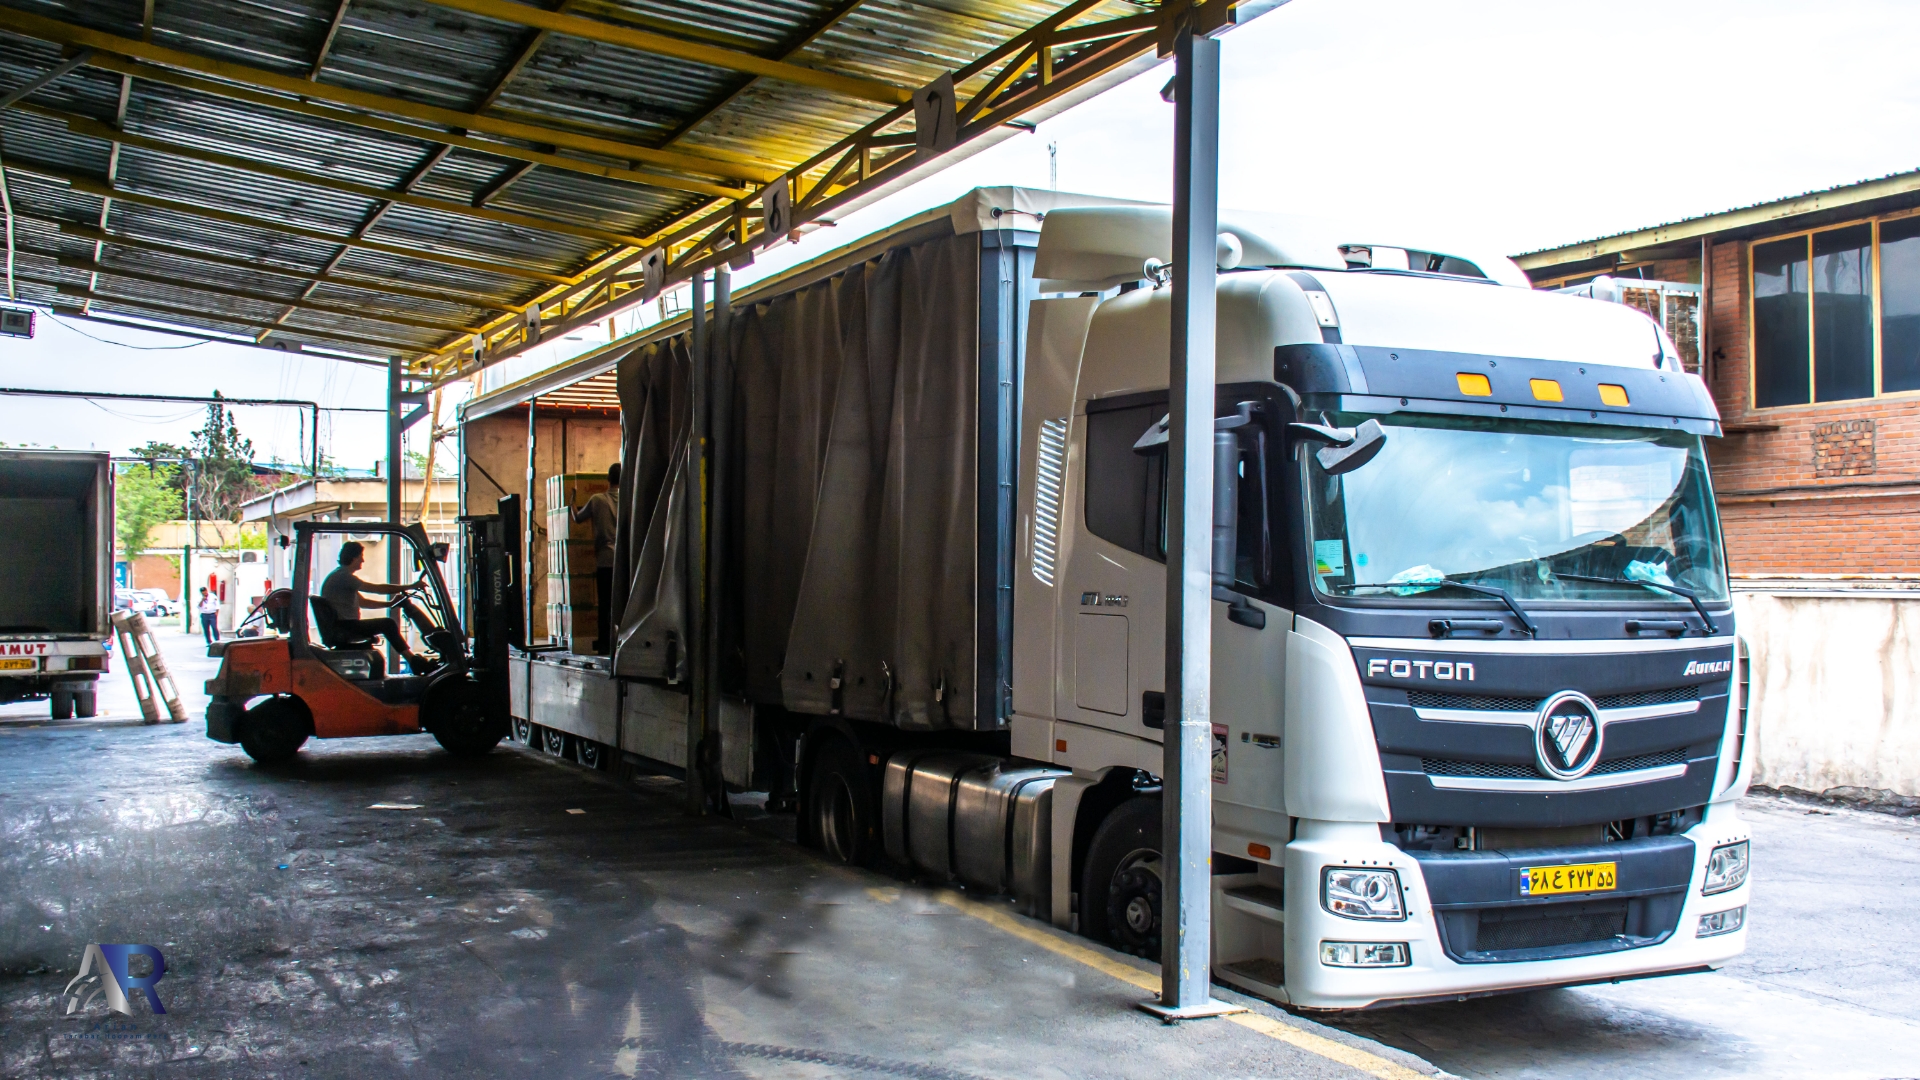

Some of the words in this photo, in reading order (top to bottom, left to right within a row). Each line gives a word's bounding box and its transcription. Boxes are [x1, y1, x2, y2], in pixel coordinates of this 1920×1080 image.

[493, 569, 502, 606] TOYOTA
[340, 659, 366, 667] 30
[1367, 659, 1474, 680] FOTON
[1597, 871, 1614, 887] ۵۵
